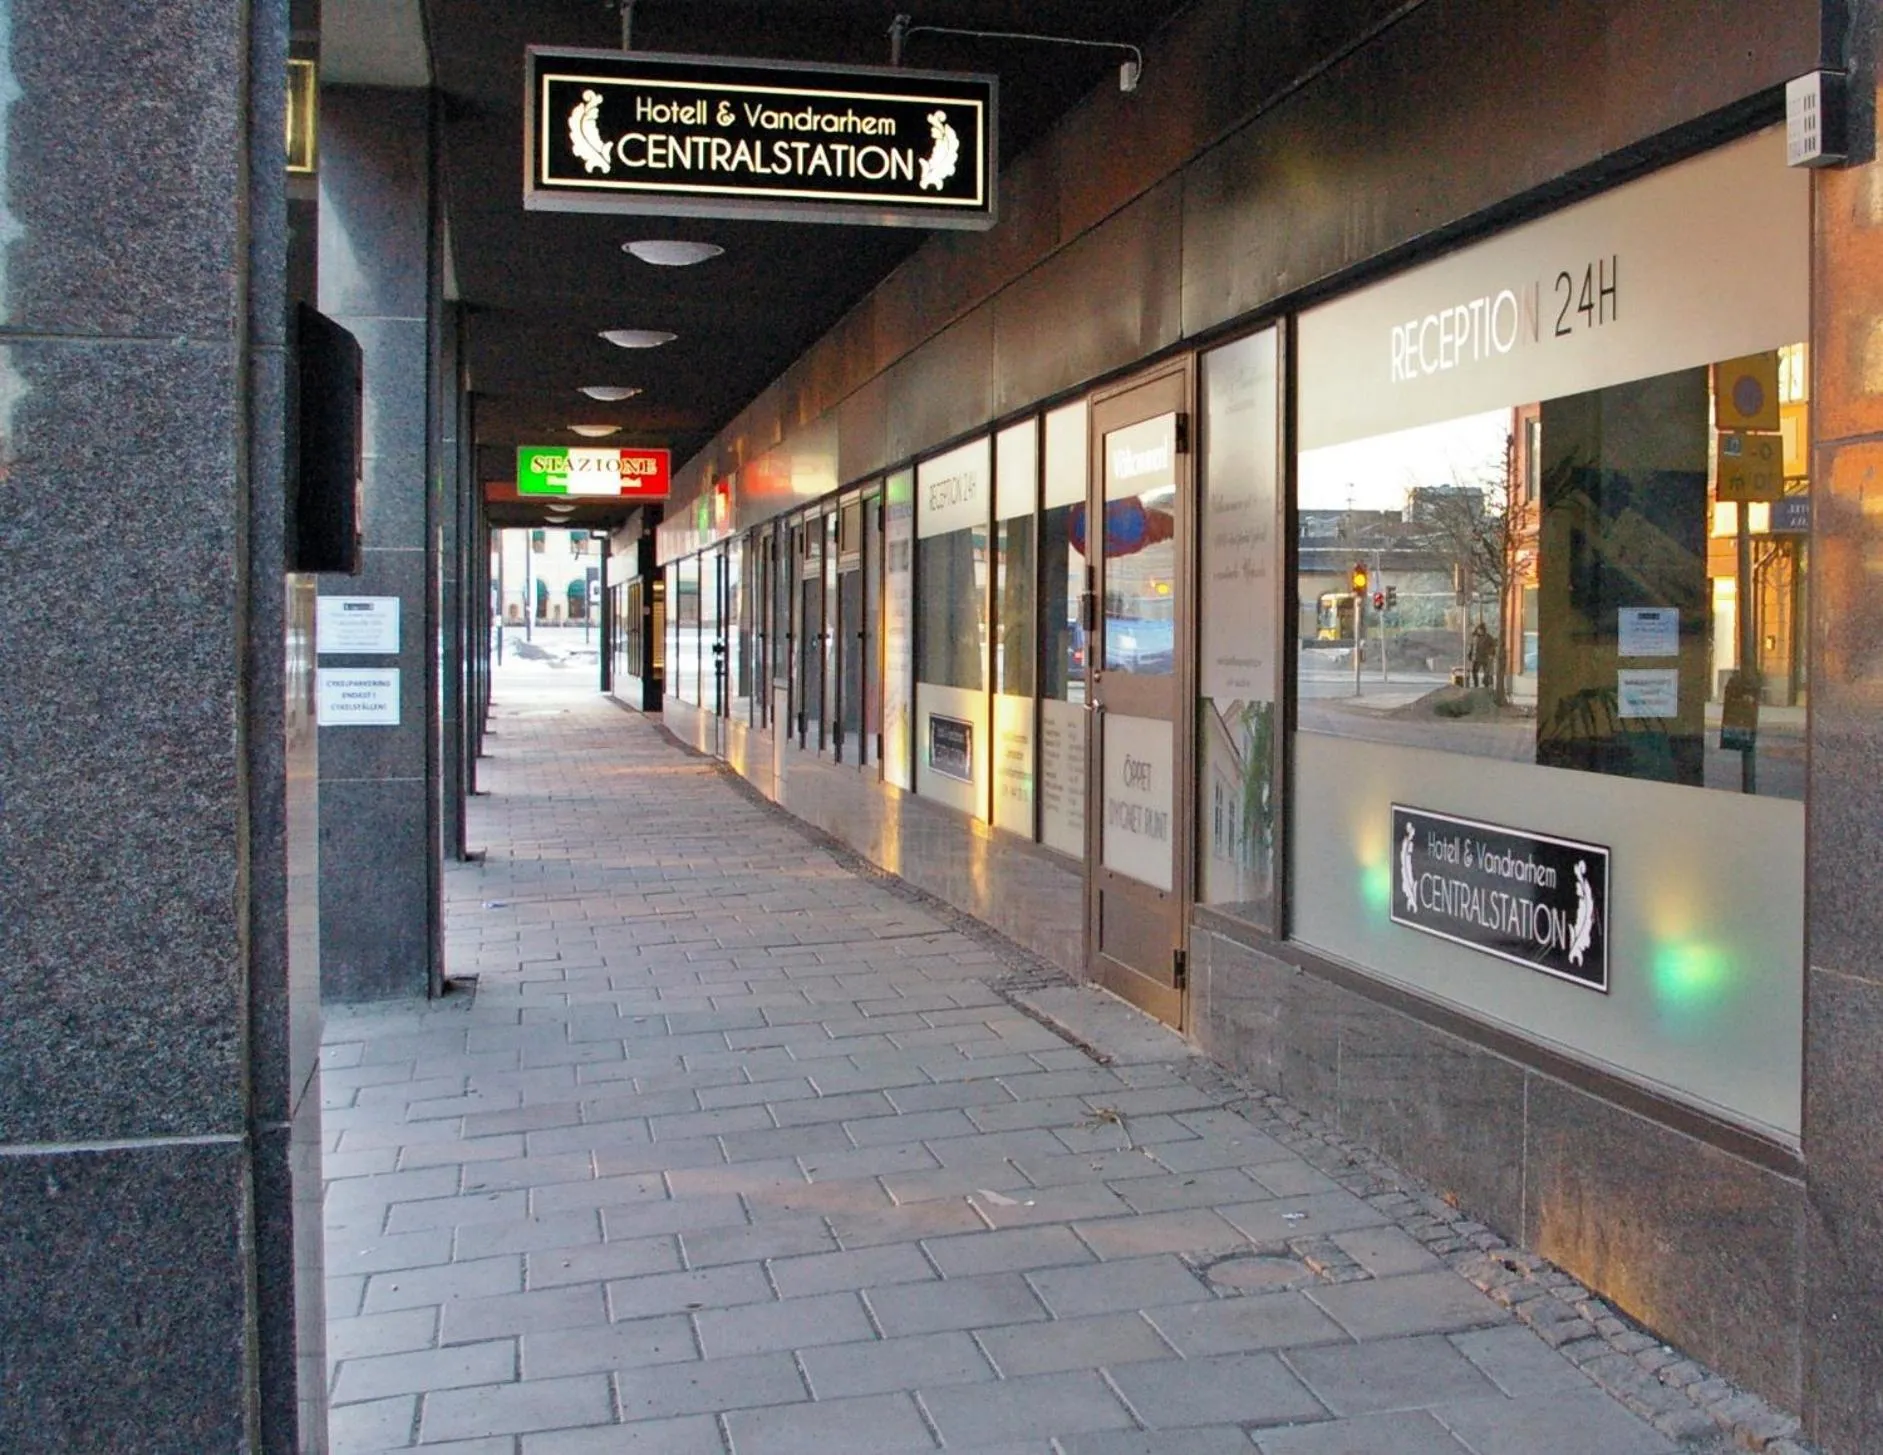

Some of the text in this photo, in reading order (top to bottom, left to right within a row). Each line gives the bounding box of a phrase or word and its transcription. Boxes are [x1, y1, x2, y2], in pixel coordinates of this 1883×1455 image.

[635, 96, 897, 136] Hotell & Vandrarhem
[616, 132, 915, 181] CENTRALSTATION
[1390, 254, 1618, 384] RECEPTION 24H
[531, 456, 658, 474] STAZIONE
[1426, 831, 1557, 889] Hotell & Vandrarhem
[1419, 872, 1567, 951] CENTRALSTATION
